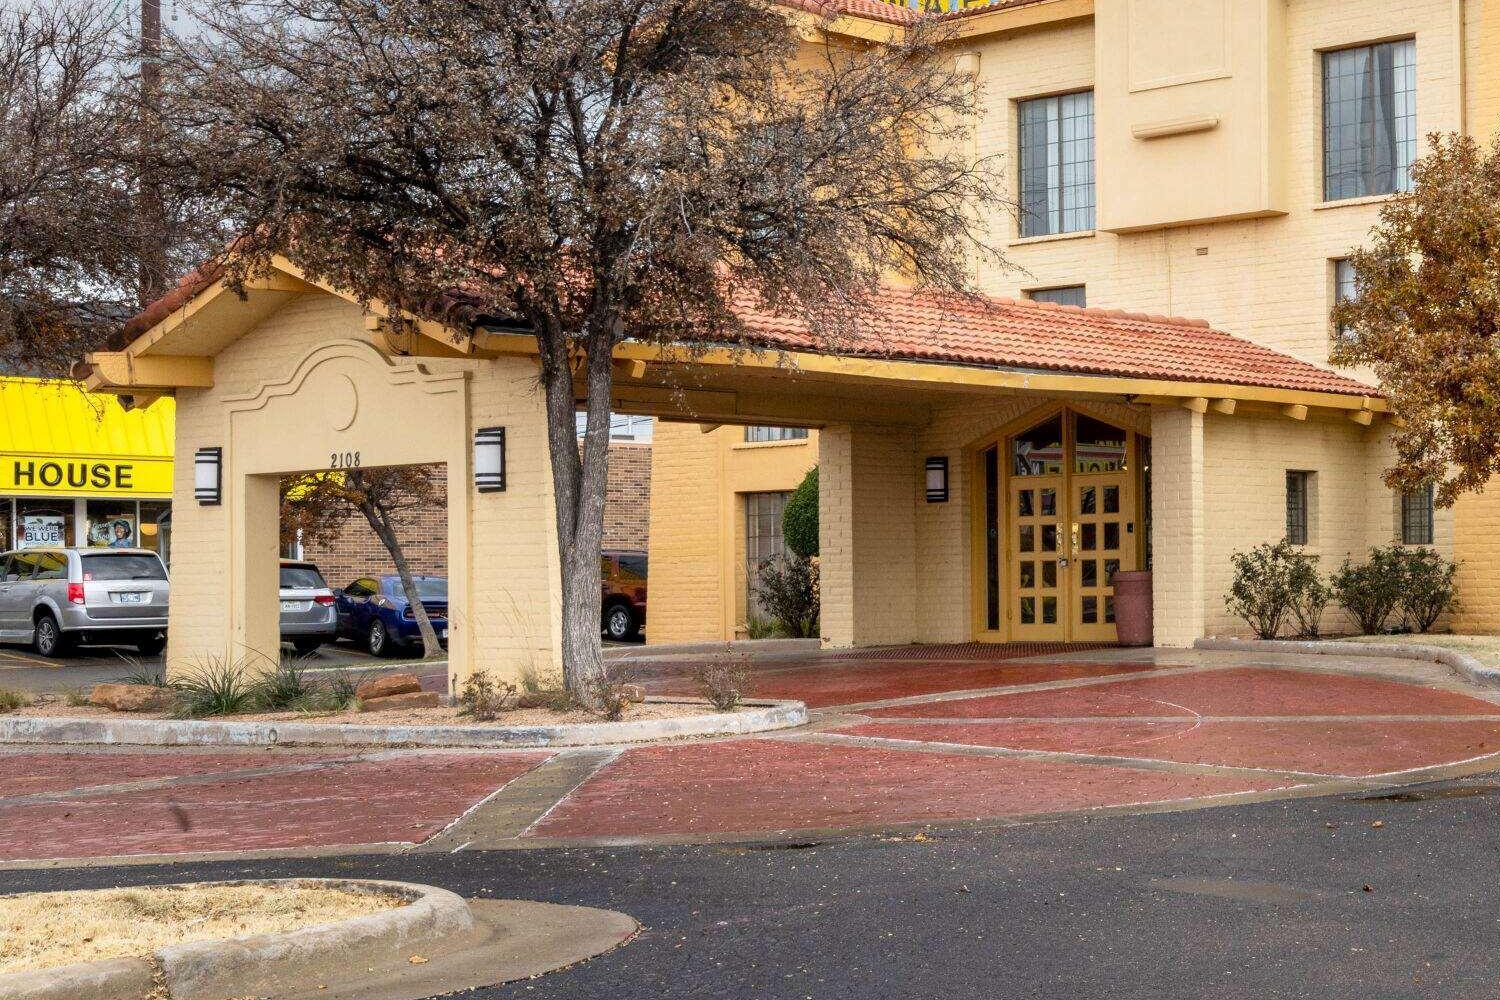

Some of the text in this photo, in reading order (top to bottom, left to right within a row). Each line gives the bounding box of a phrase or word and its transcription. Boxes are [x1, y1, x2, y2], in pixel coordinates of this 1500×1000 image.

[331, 452, 361, 468] 2108
[14, 461, 133, 489] HOUSE
[25, 532, 58, 542] BLUE
